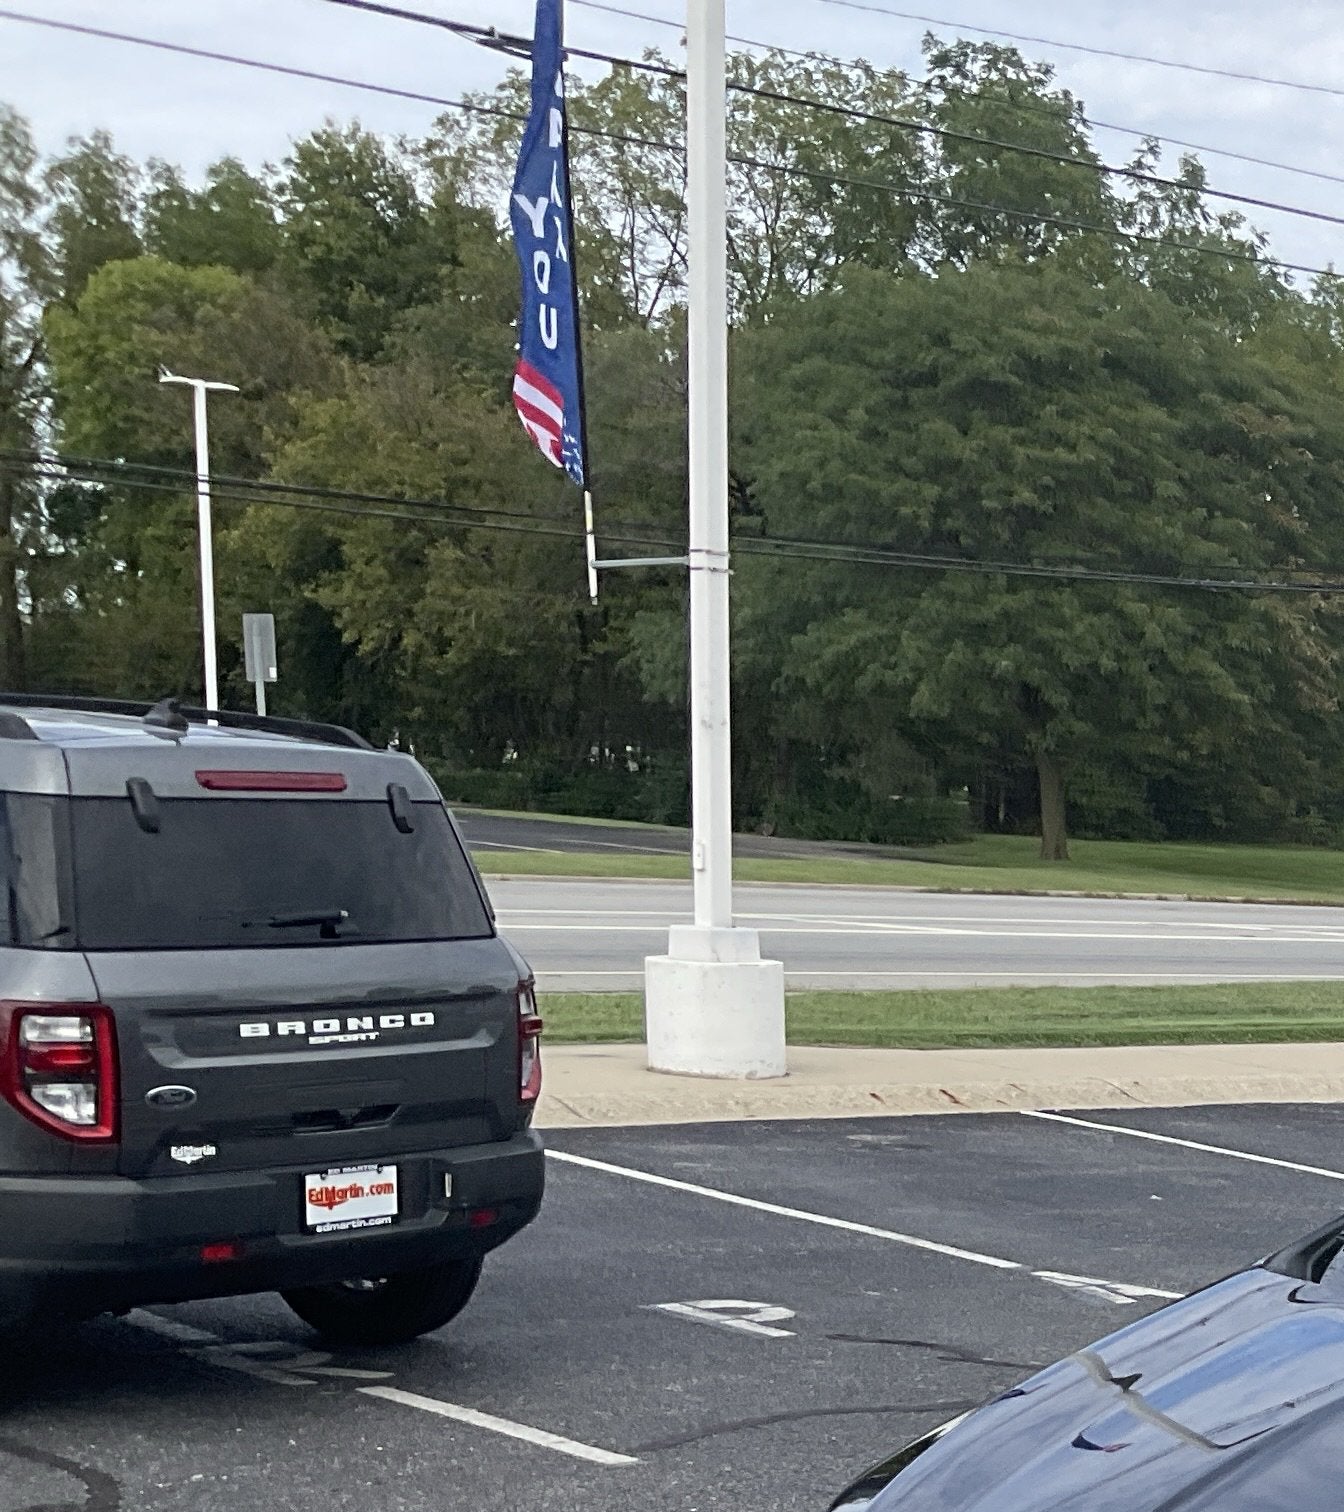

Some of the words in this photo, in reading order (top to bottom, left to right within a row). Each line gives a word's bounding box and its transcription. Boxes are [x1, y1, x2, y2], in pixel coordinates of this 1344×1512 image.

[513, 193, 557, 349] YOU
[240, 1012, 435, 1038] BRONCO
[315, 1216, 392, 1233] edmartin.com
